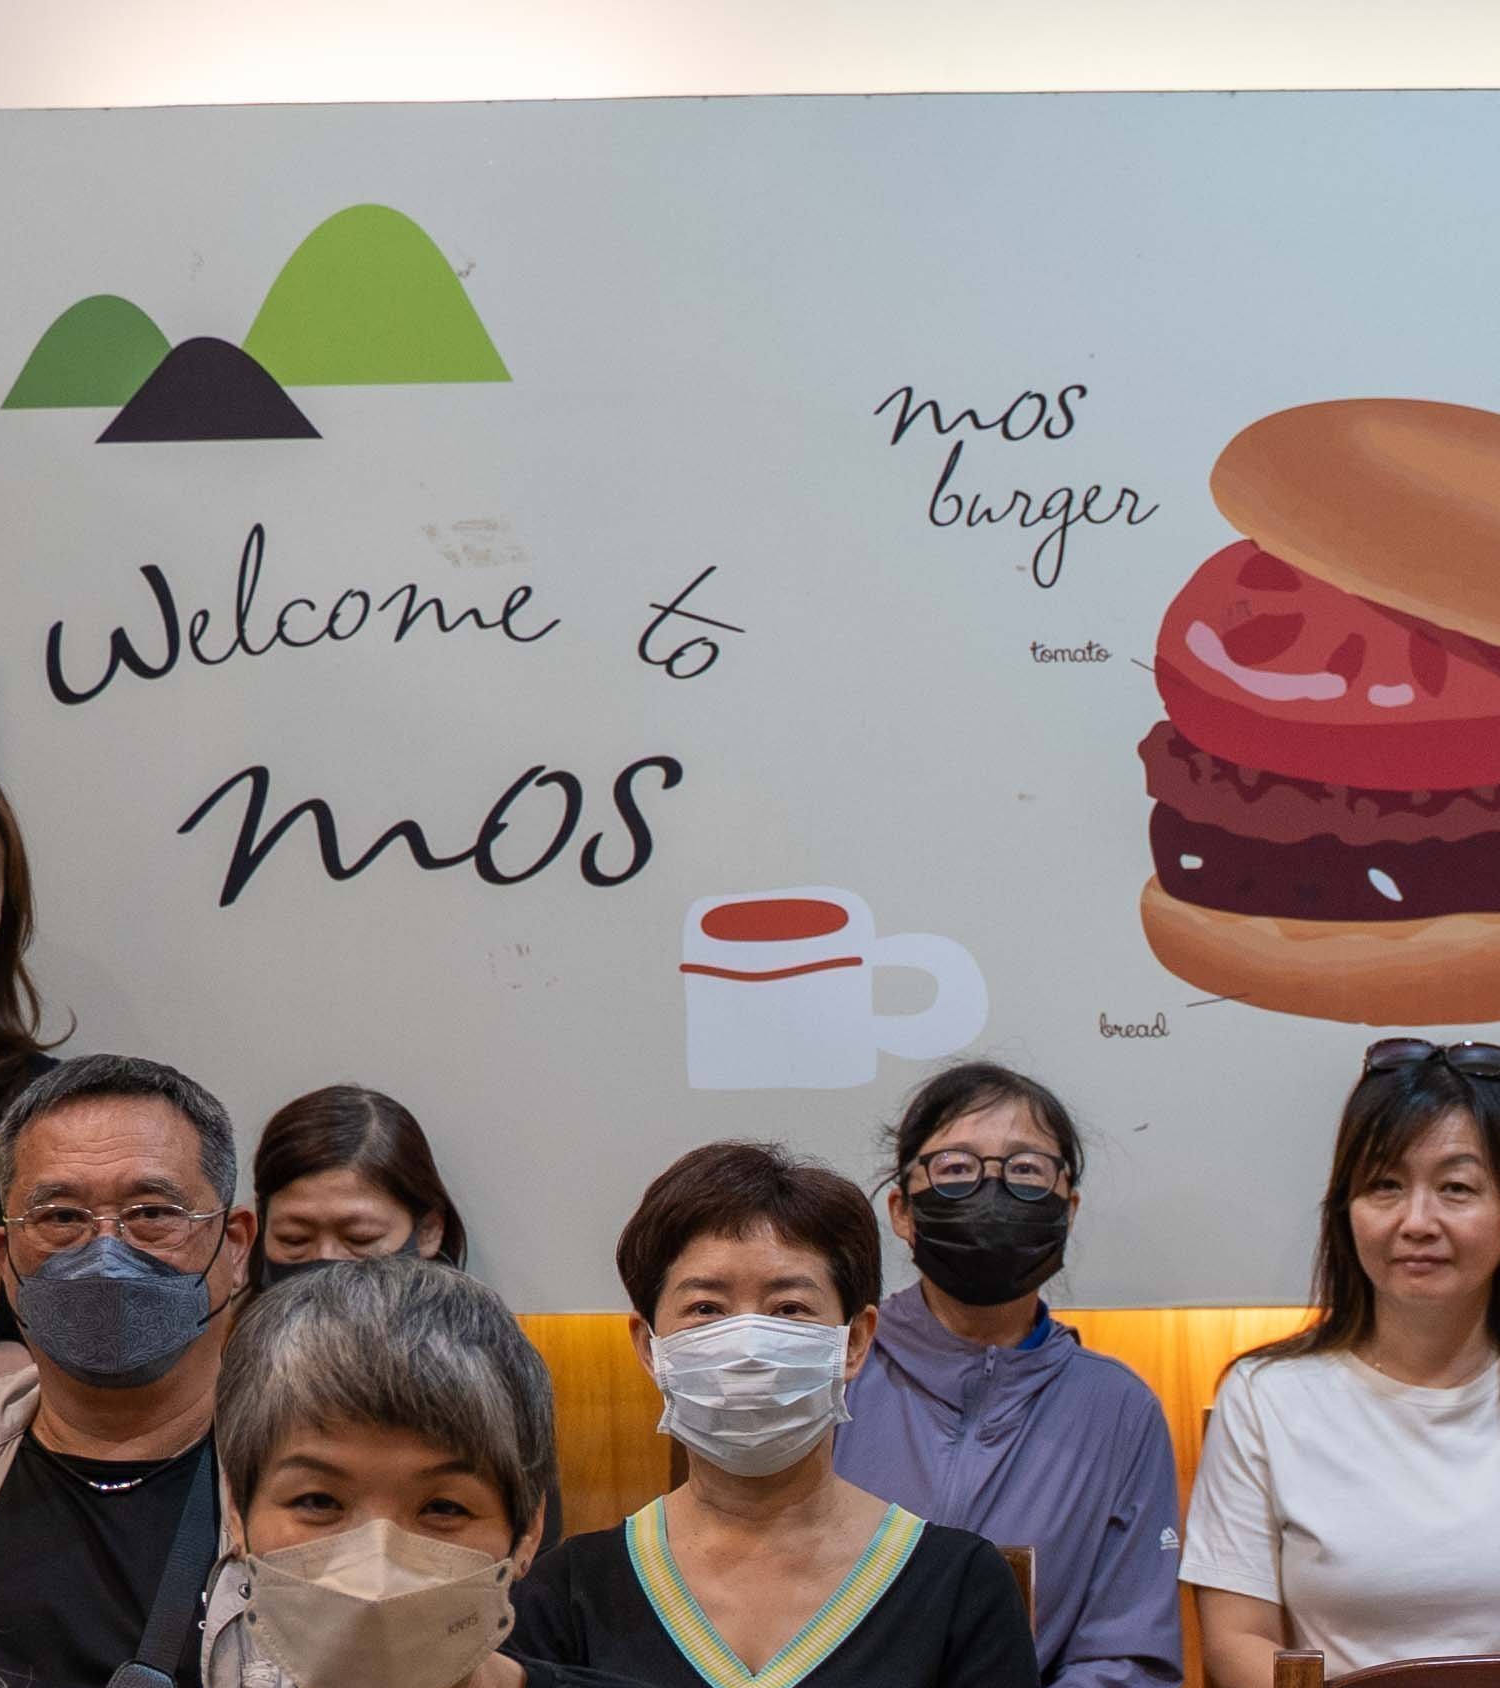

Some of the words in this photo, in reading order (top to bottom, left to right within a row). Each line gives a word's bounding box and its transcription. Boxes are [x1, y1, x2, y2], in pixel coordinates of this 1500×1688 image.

[873, 383, 1088, 447] mos
[926, 439, 1160, 590] burger
[45, 522, 562, 706] Welcome
[637, 565, 746, 680] to
[1029, 638, 1112, 664] tomato
[1100, 1014, 1170, 1041] bread
